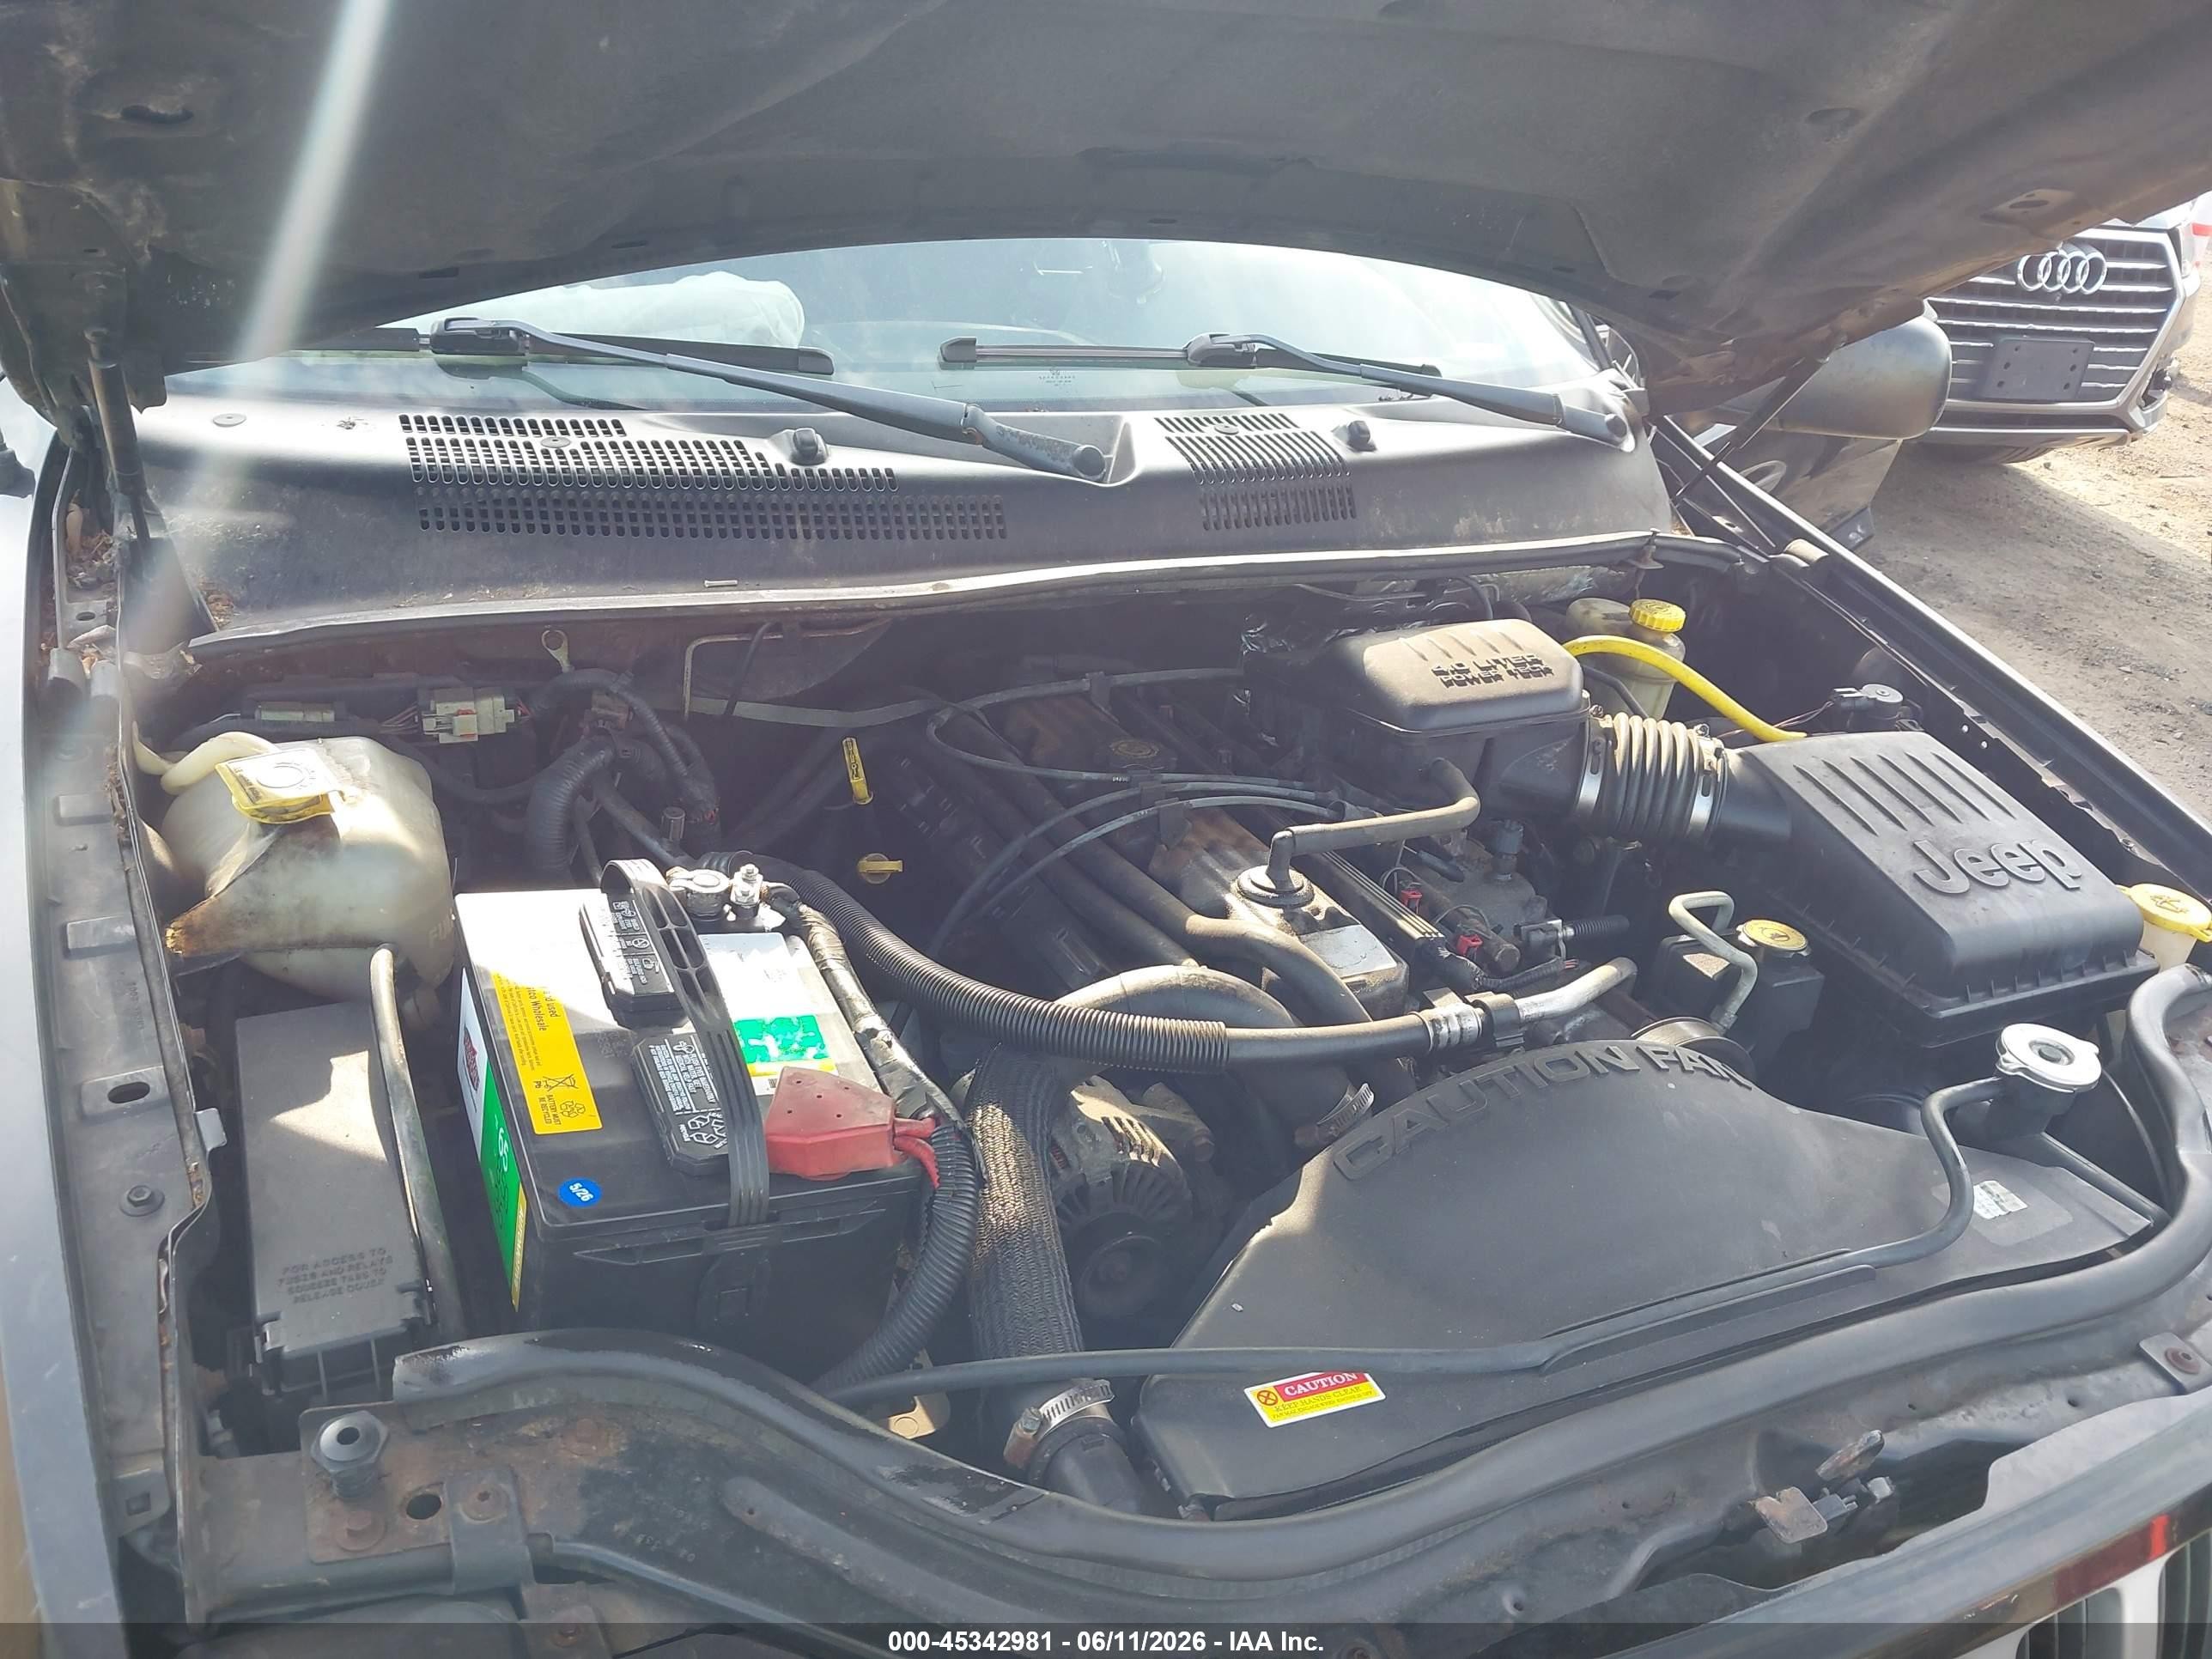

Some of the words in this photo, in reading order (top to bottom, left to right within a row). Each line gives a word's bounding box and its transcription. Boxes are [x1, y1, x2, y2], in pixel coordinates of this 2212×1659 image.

[1913, 839, 2081, 893] Jeep
[530, 1000, 547, 1031] Wholesale
[546, 1002, 558, 1018] used
[534, 1080, 543, 1089] Pb
[1334, 1045, 1640, 1182] CAUTION
[1637, 1044, 1753, 1091] FAN
[569, 1182, 594, 1202] 5/26
[1284, 1372, 1358, 1396] CAUTION
[1274, 1401, 1298, 1413] KEEP
[1299, 1393, 1331, 1407] HANDS
[1333, 1386, 1362, 1399] CLEAR
